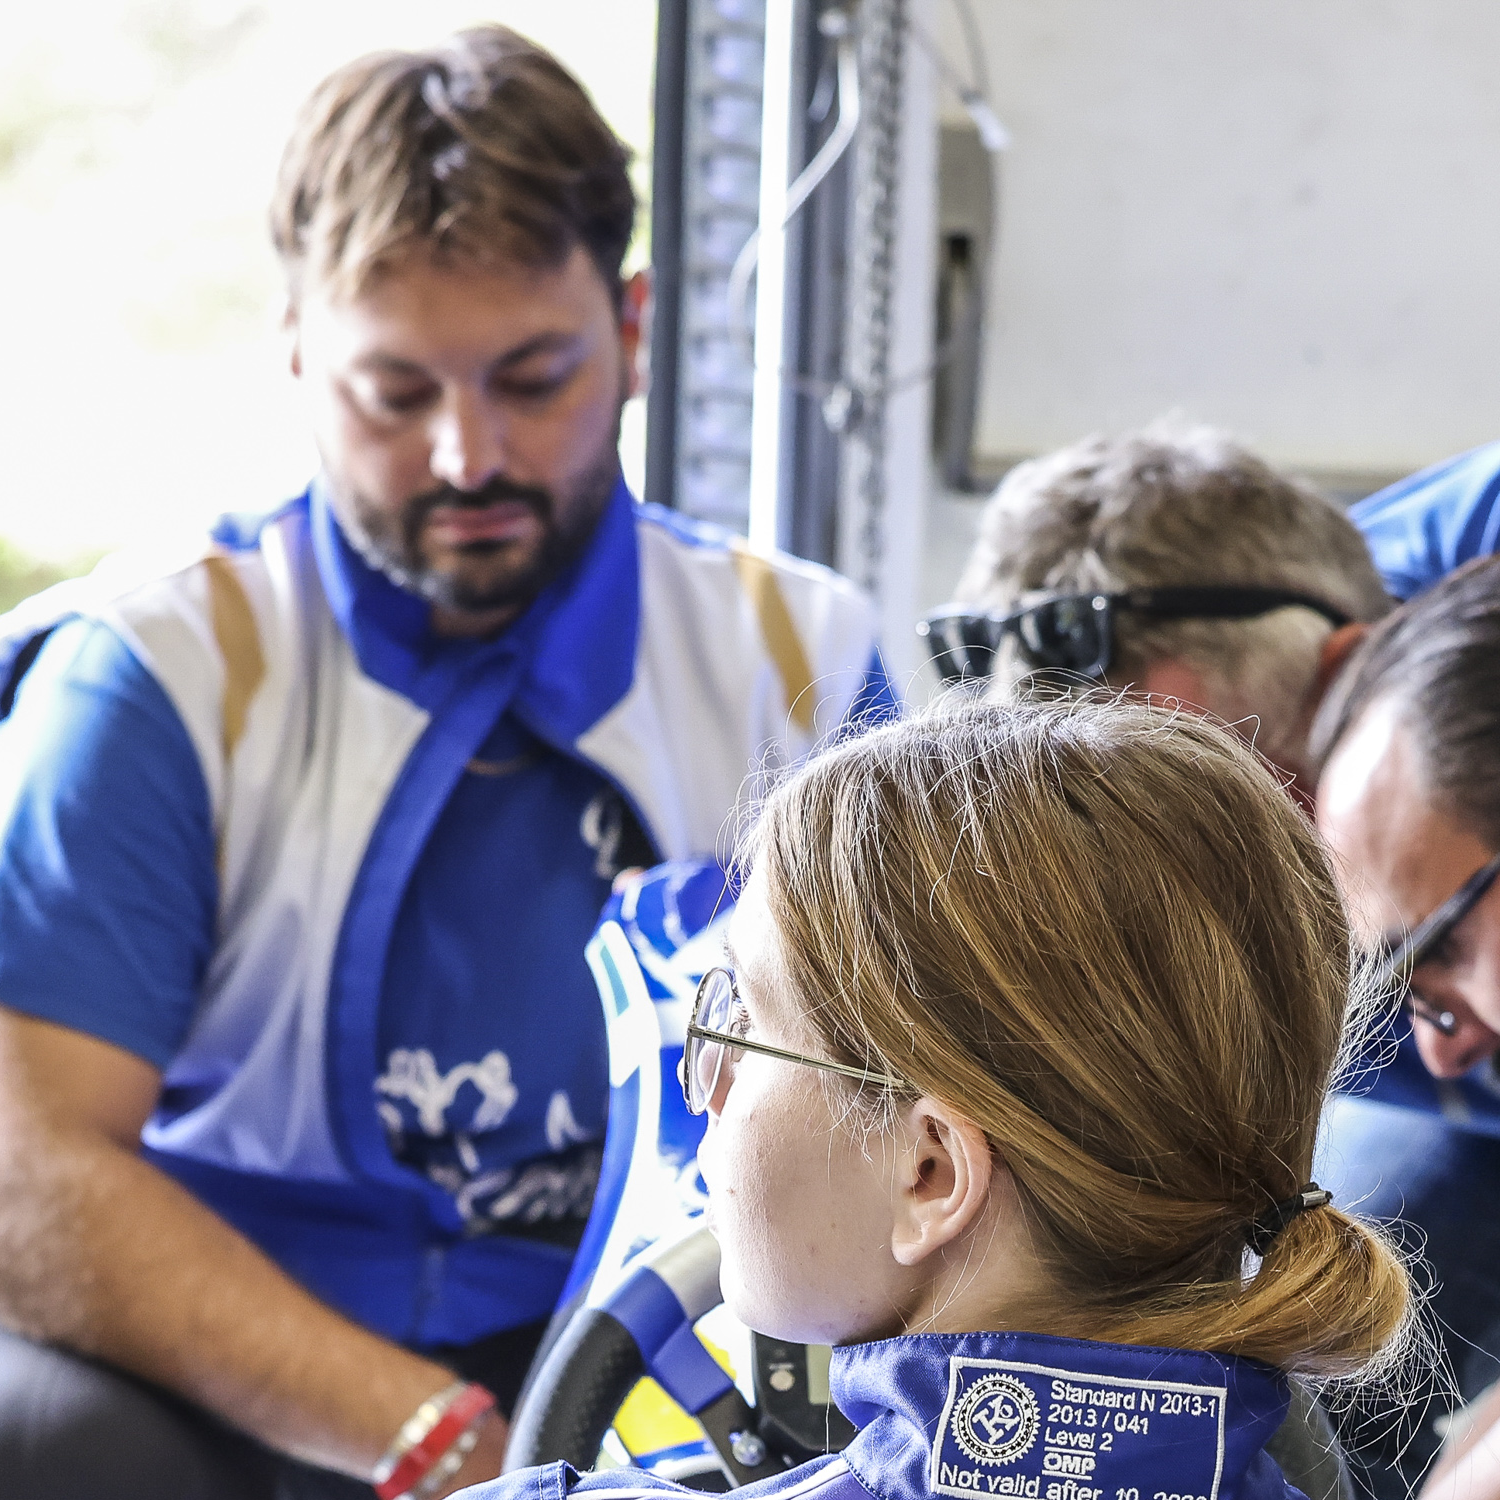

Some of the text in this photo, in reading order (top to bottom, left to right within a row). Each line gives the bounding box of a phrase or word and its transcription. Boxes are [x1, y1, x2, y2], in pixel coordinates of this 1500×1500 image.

[1050, 1380, 1217, 1418] Standard N 2013-1
[1046, 1404, 1098, 1428] 2013
[1113, 1412, 1150, 1435] 041
[1043, 1426, 1114, 1452] Level 2
[939, 1461, 985, 1490] Not
[987, 1472, 1041, 1499] valid
[1042, 1452, 1097, 1477] OMP
